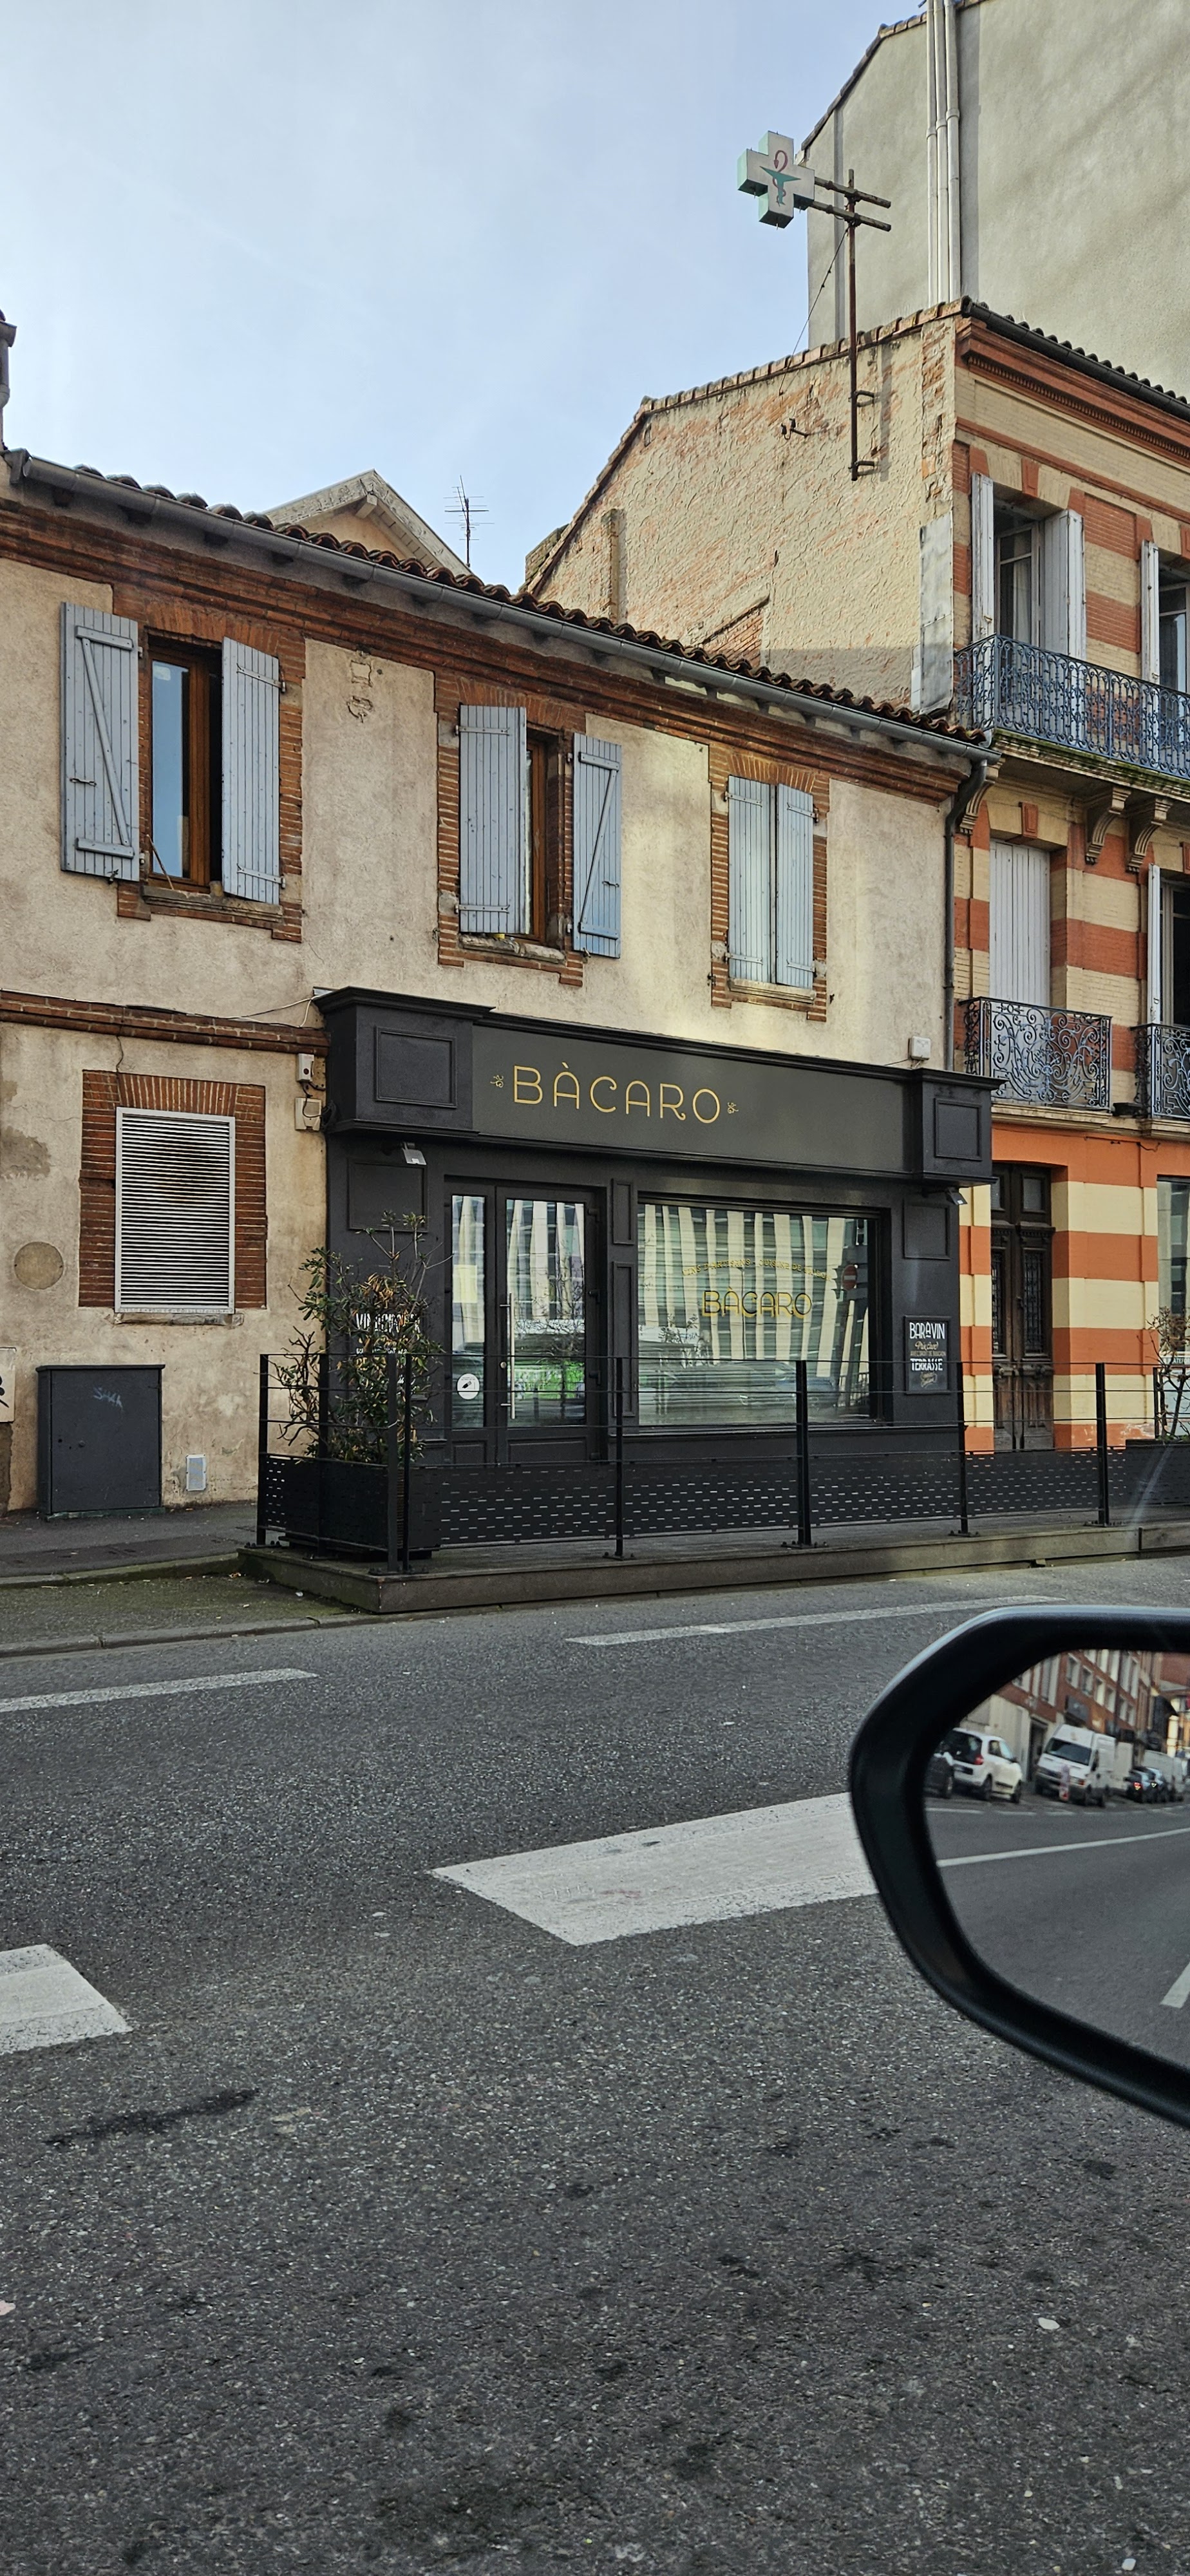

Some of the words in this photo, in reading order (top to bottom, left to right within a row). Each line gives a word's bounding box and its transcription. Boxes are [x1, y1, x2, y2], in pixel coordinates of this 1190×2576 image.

[514, 1062, 721, 1124] BÀCARO
[792, 1263, 802, 1271] DE
[702, 1286, 812, 1318] BÀCARO
[910, 1358, 943, 1371] TERRASSE
